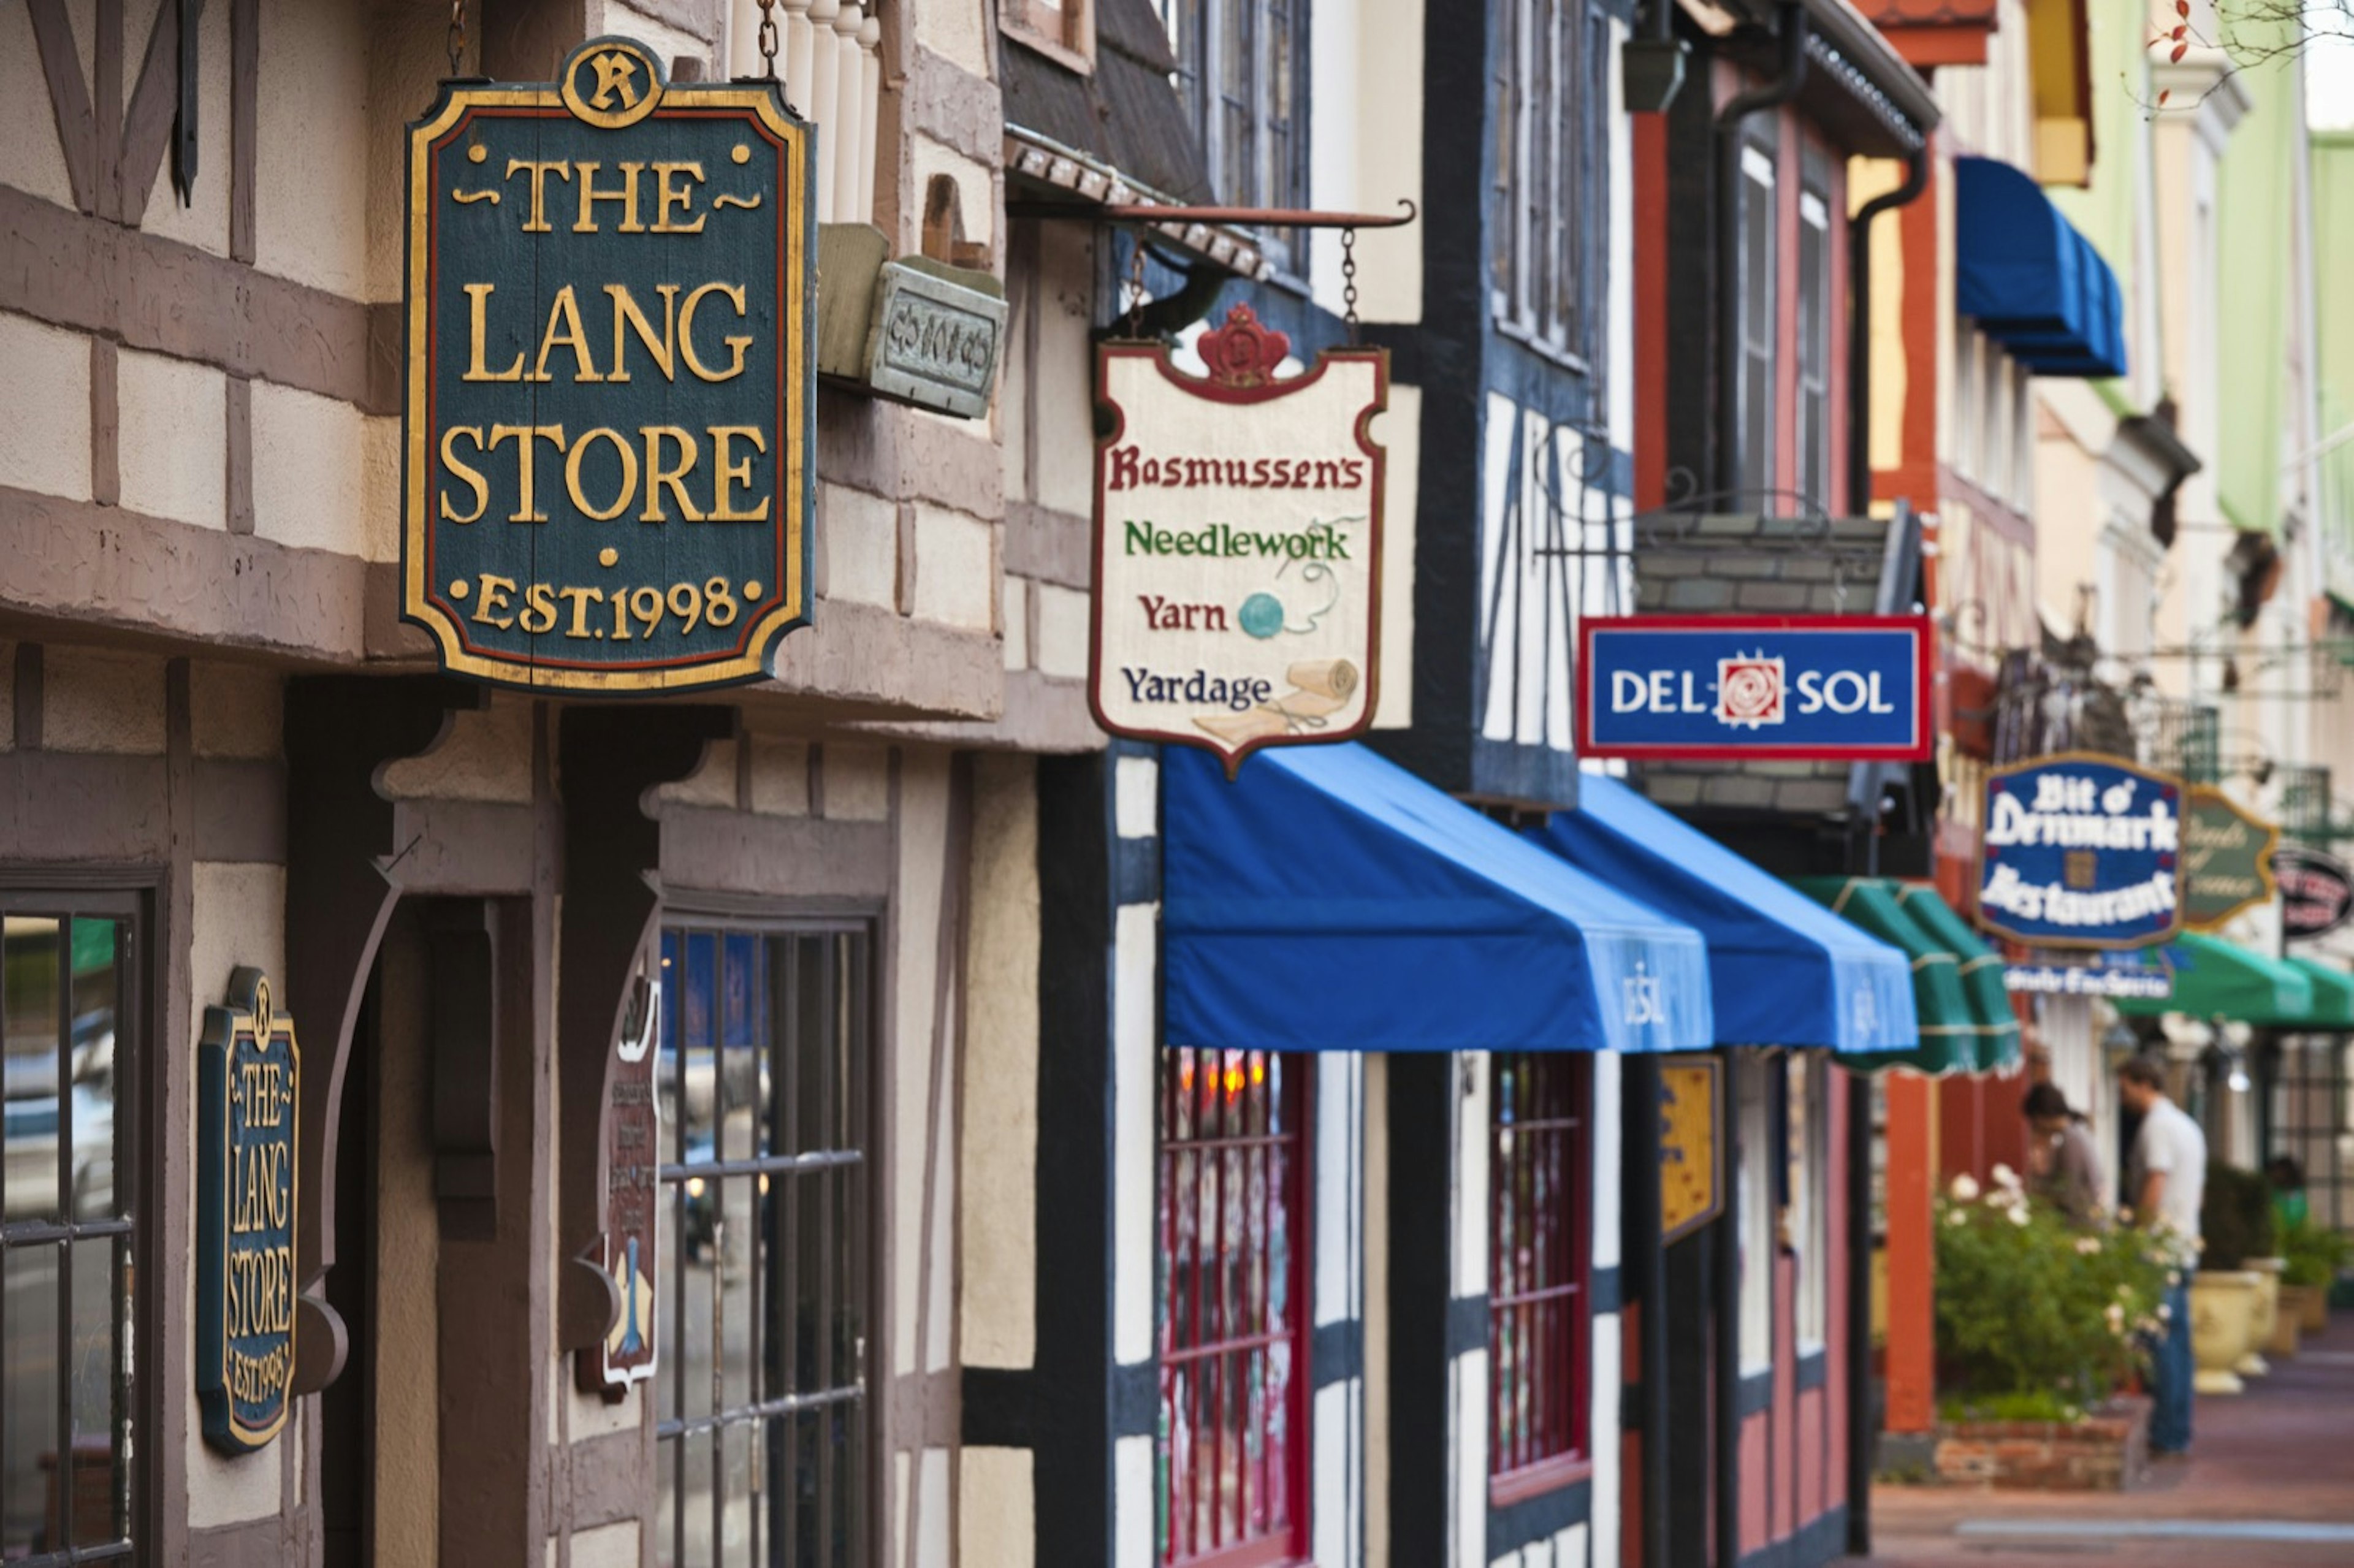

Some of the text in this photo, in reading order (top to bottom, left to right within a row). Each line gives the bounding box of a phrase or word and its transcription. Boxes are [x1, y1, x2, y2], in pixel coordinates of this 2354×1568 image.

[505, 159, 706, 233] THE
[462, 282, 753, 382] LANG
[440, 424, 770, 523] STORE
[1109, 445, 1363, 490] Rasmussen's
[1124, 520, 1351, 560] Needlework
[1138, 595, 1228, 631] Yarn
[1121, 667, 1271, 711] Yardage
[1612, 671, 1894, 714] DEL SOL
[2031, 774, 2097, 812] Bit
[242, 1063, 281, 1127] THE
[232, 1141, 288, 1232] LANG
[229, 1246, 291, 1338] STORE
